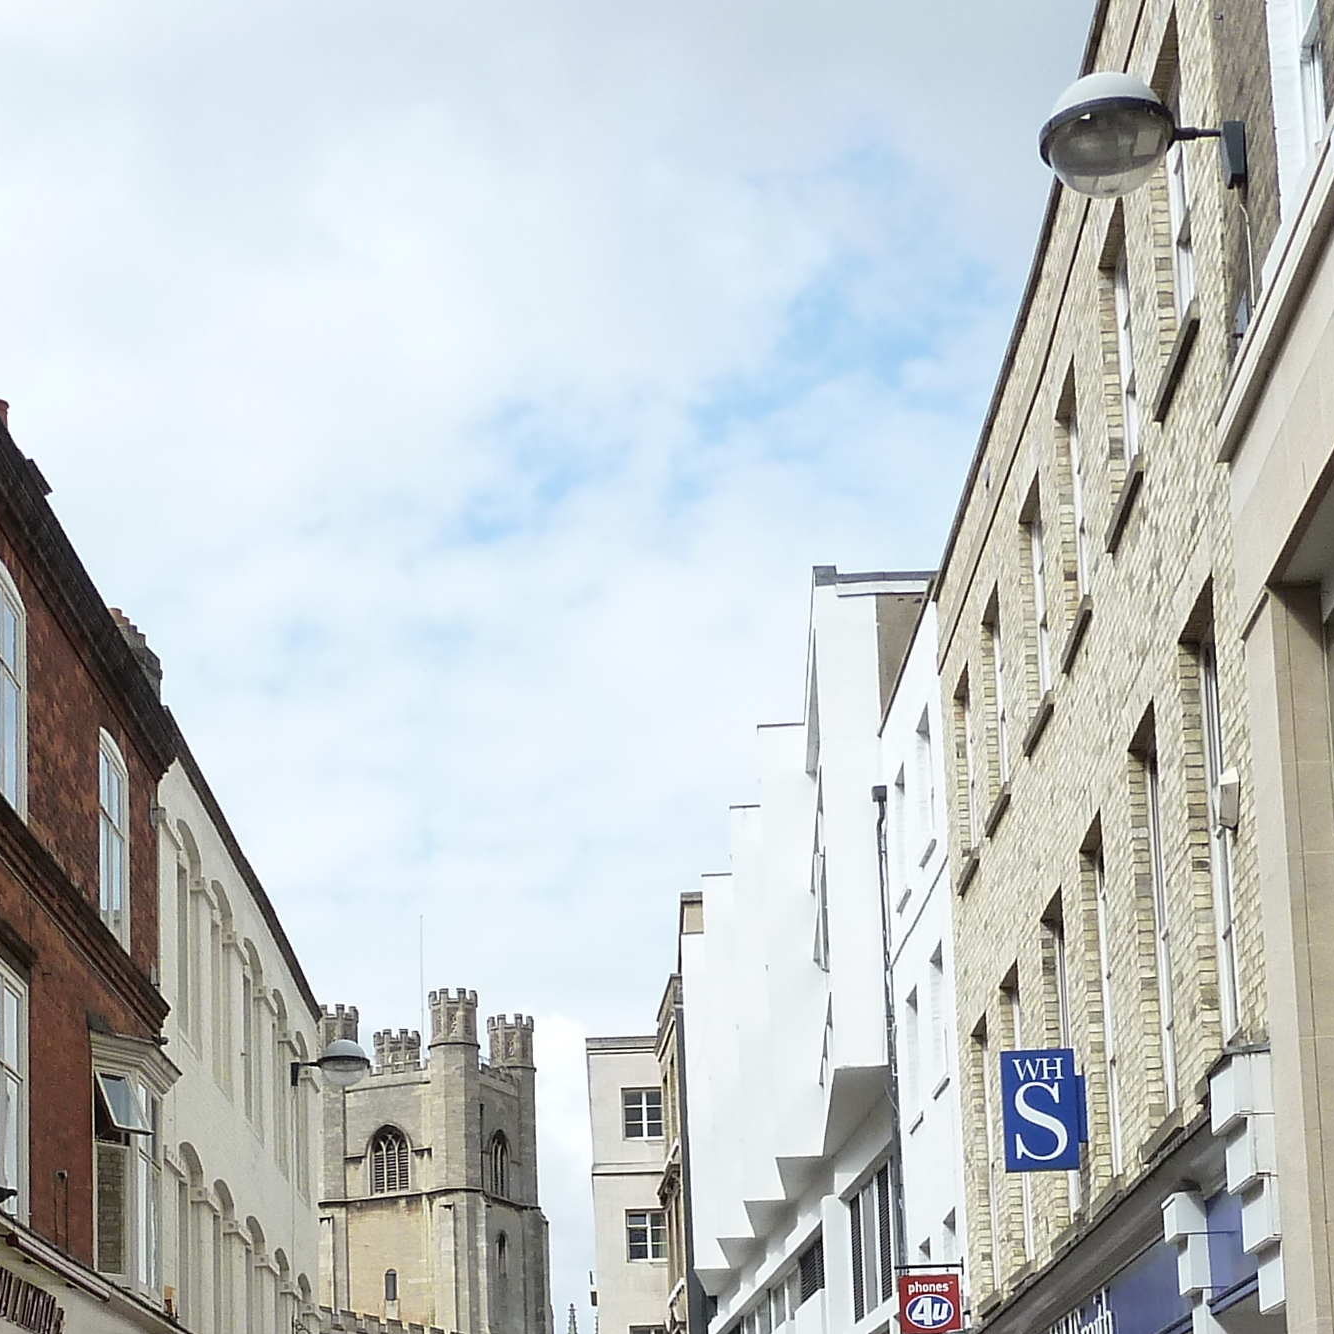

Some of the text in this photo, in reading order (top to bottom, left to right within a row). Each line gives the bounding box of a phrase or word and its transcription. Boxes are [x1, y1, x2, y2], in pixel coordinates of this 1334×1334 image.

[1012, 1057, 1065, 1081] WH
[1014, 1081, 1069, 1161] S
[908, 1281, 949, 1295] phones
[911, 1297, 948, 1325] 4u
